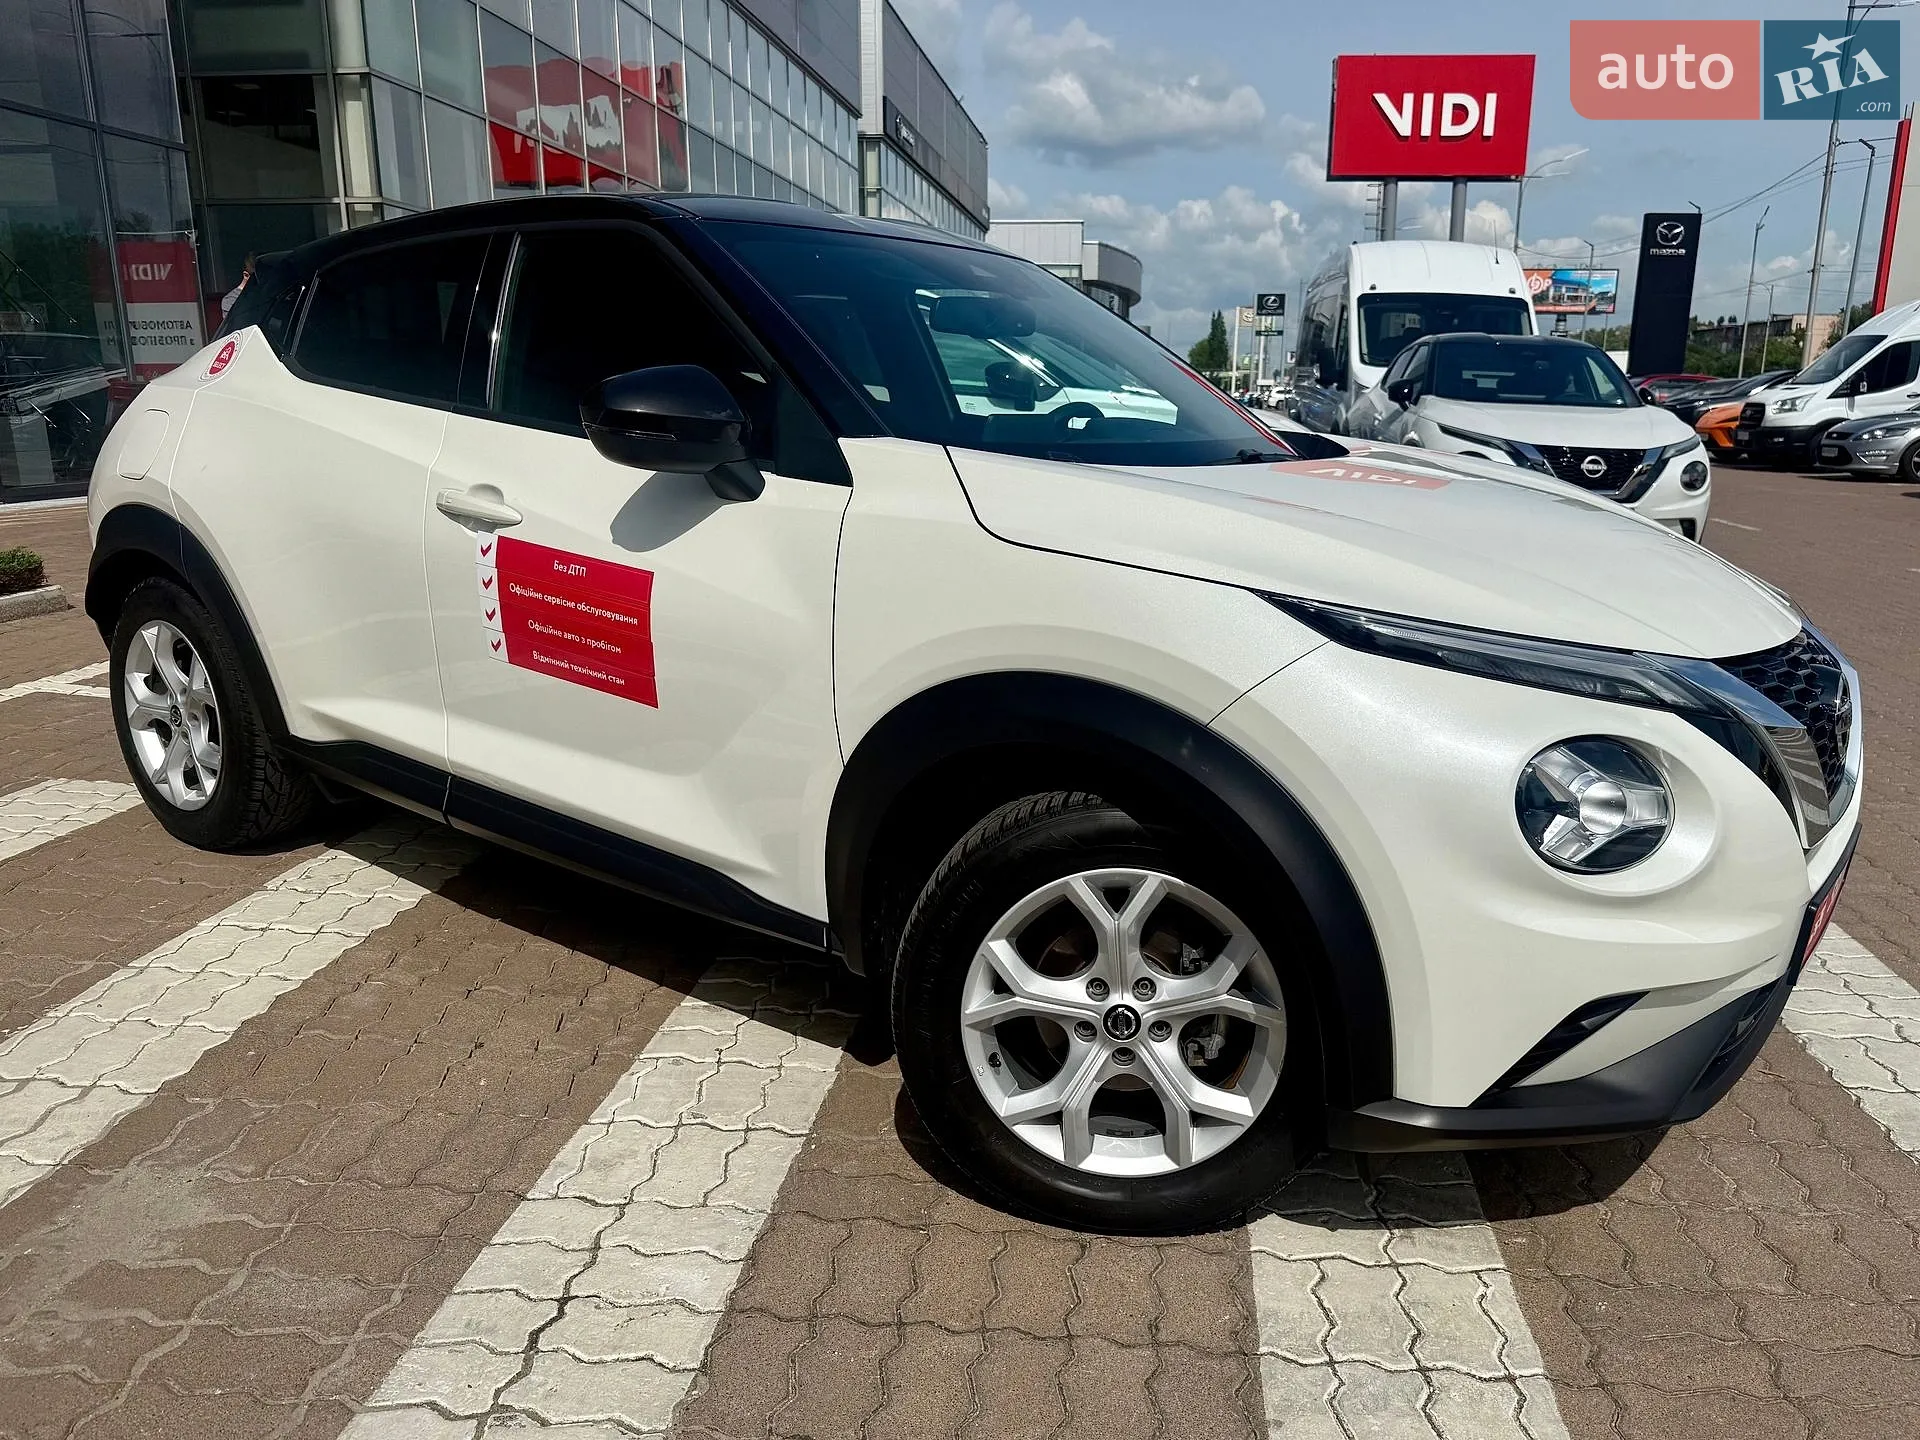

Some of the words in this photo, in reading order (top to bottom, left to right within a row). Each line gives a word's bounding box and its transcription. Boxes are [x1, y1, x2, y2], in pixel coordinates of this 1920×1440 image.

[1372, 92, 1498, 137] VIDI
[553, 560, 568, 573] Без
[568, 563, 587, 578] ДТП
[509, 582, 543, 601] Офіційне
[543, 593, 576, 611] сервісне
[576, 602, 638, 626] обслуговування
[528, 619, 562, 638] Офіційне
[563, 630, 580, 643] авто
[581, 635, 586, 644] з
[586, 638, 622, 654] пробігом
[532, 650, 570, 670] Відмінний
[569, 664, 607, 681] технічний
[607, 674, 625, 686] стан
